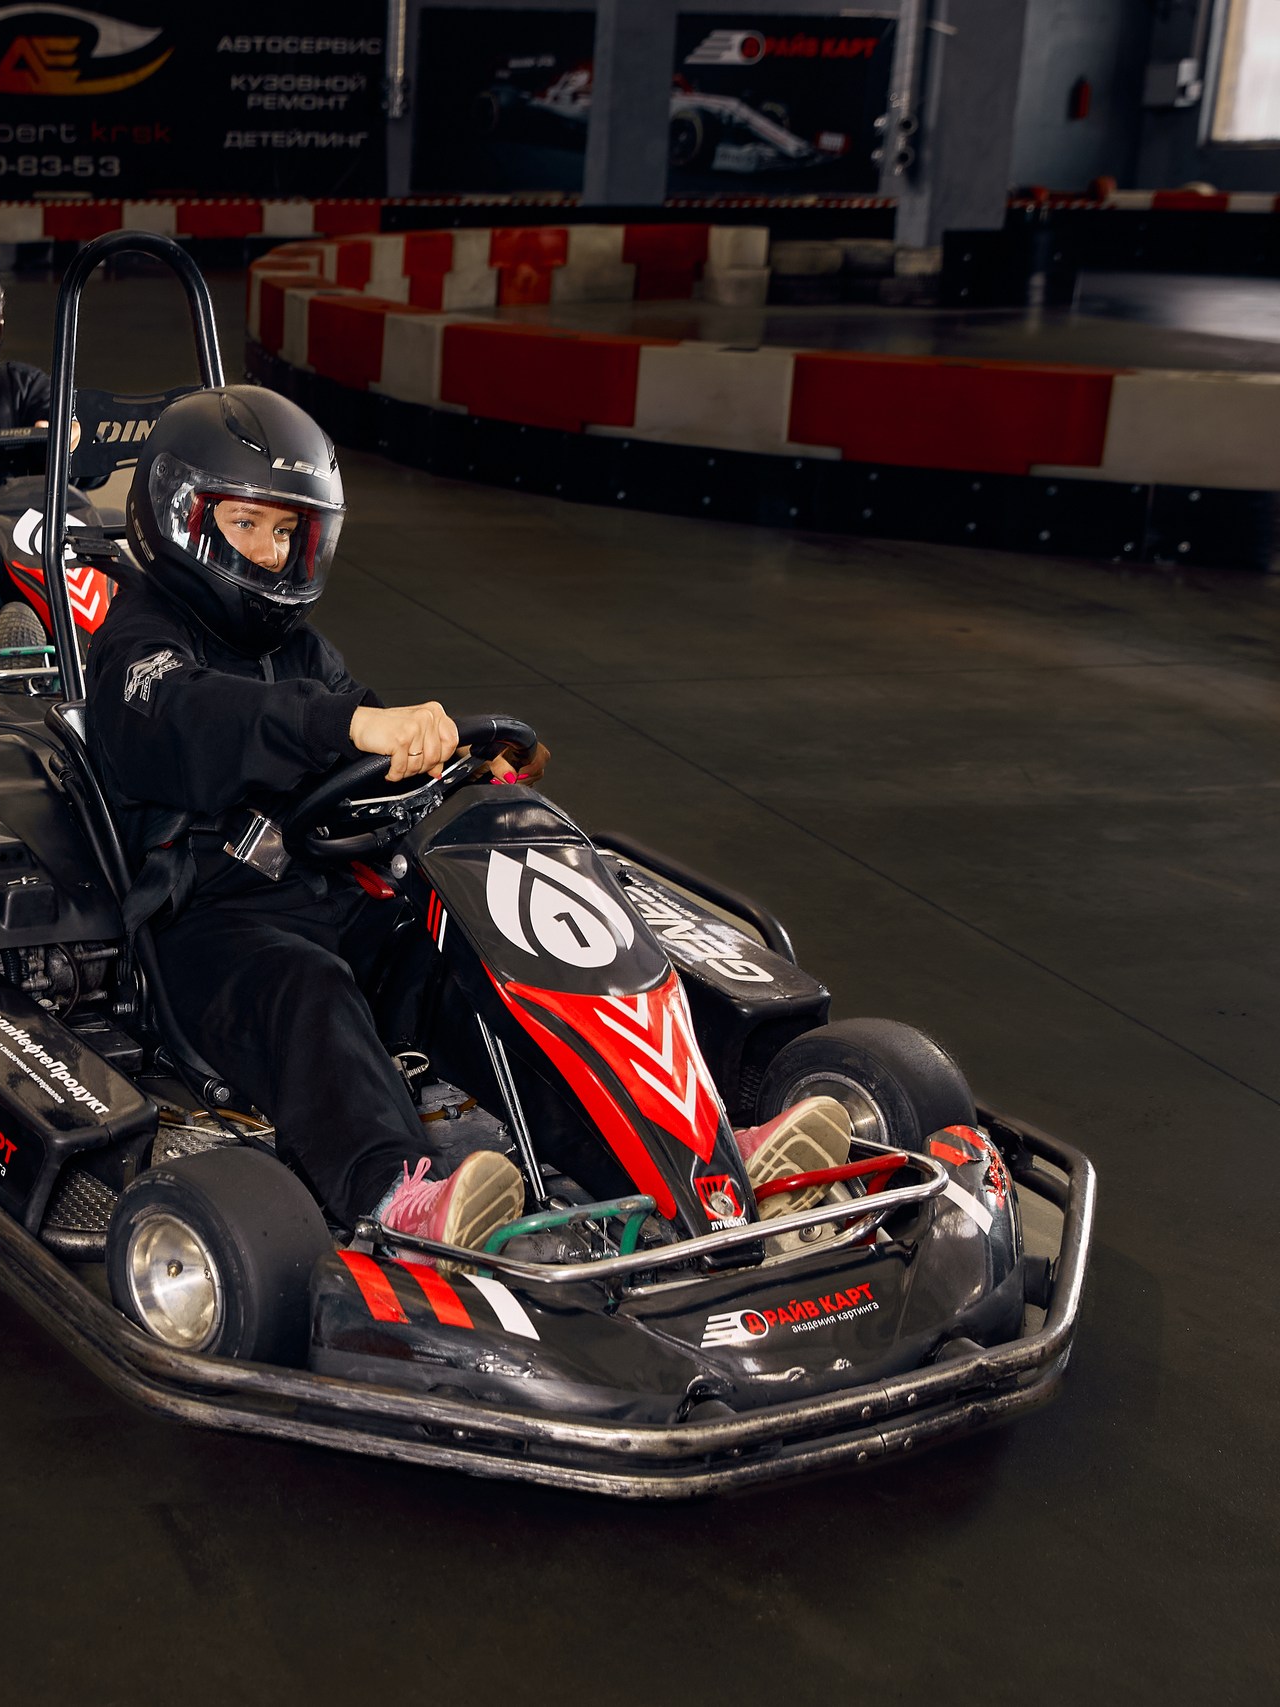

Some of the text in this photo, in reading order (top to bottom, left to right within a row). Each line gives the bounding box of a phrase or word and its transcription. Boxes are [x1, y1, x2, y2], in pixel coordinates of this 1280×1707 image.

[217, 35, 383, 55] АВТОСЕРВИС
[230, 72, 367, 92] КУЗОВНОЙ
[247, 93, 350, 111] РЕМОНТ
[223, 128, 369, 149] ДЕТЕЙЛИНГ
[553, 911, 590, 948] 1
[710, 1216, 748, 1231] ЛУКОЙЛ
[818, 1282, 875, 1315] КАРТ
[791, 1300, 880, 1334] академия картинга
